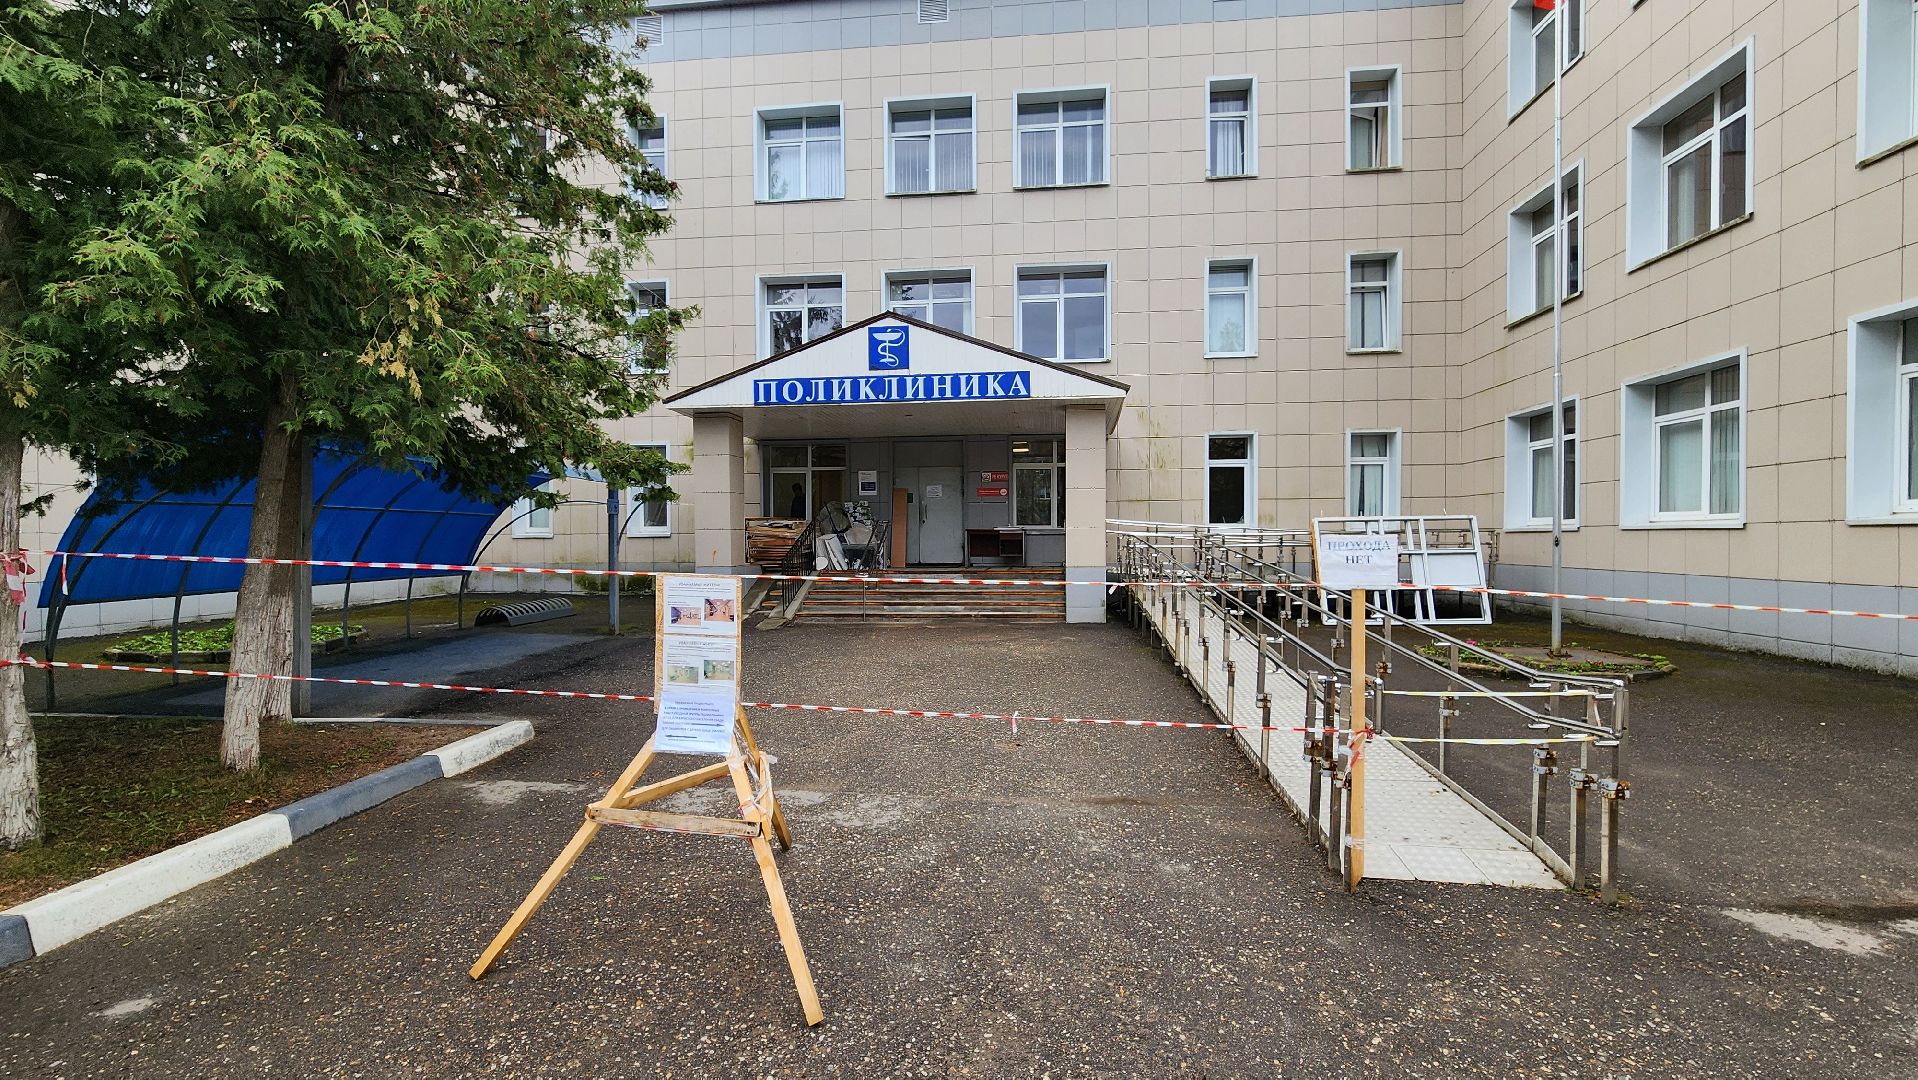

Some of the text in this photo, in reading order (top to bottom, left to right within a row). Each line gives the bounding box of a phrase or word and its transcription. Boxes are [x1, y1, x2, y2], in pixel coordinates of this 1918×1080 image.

[757, 372, 1029, 403] ПОЛИКЛИНИКА
[1328, 540, 1391, 551] ПРОХОДА
[1346, 555, 1373, 564] НЕТ
